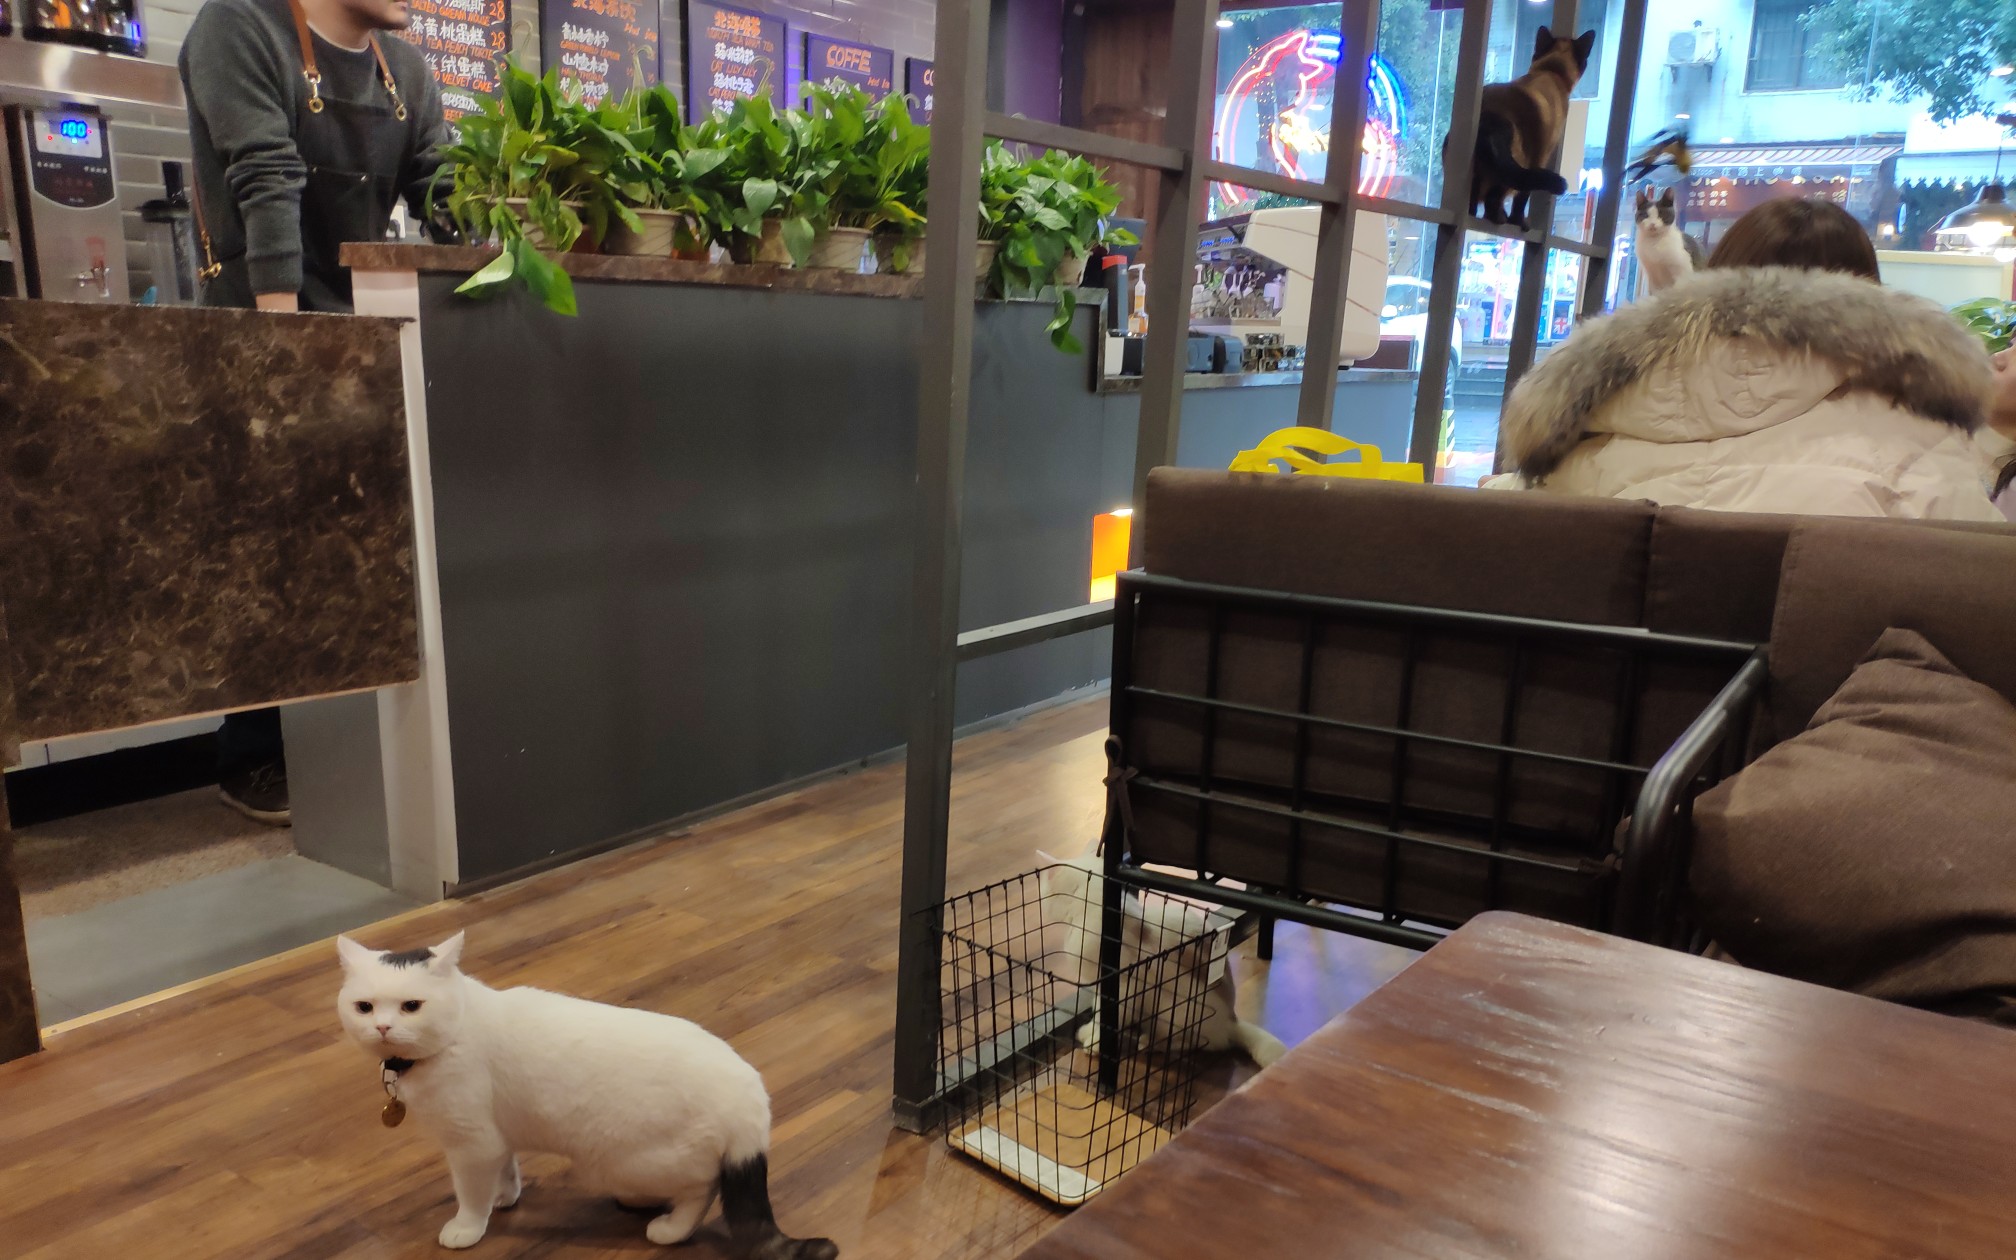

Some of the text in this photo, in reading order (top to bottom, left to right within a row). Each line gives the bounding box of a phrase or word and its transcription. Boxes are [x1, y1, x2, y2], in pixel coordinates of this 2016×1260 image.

[489, 0, 505, 20] 28
[426, 36, 443, 50] TEA
[490, 31, 506, 50] 28
[825, 45, 872, 72] COFFE
[472, 79, 493, 93] CAKE
[62, 121, 87, 137] 100
